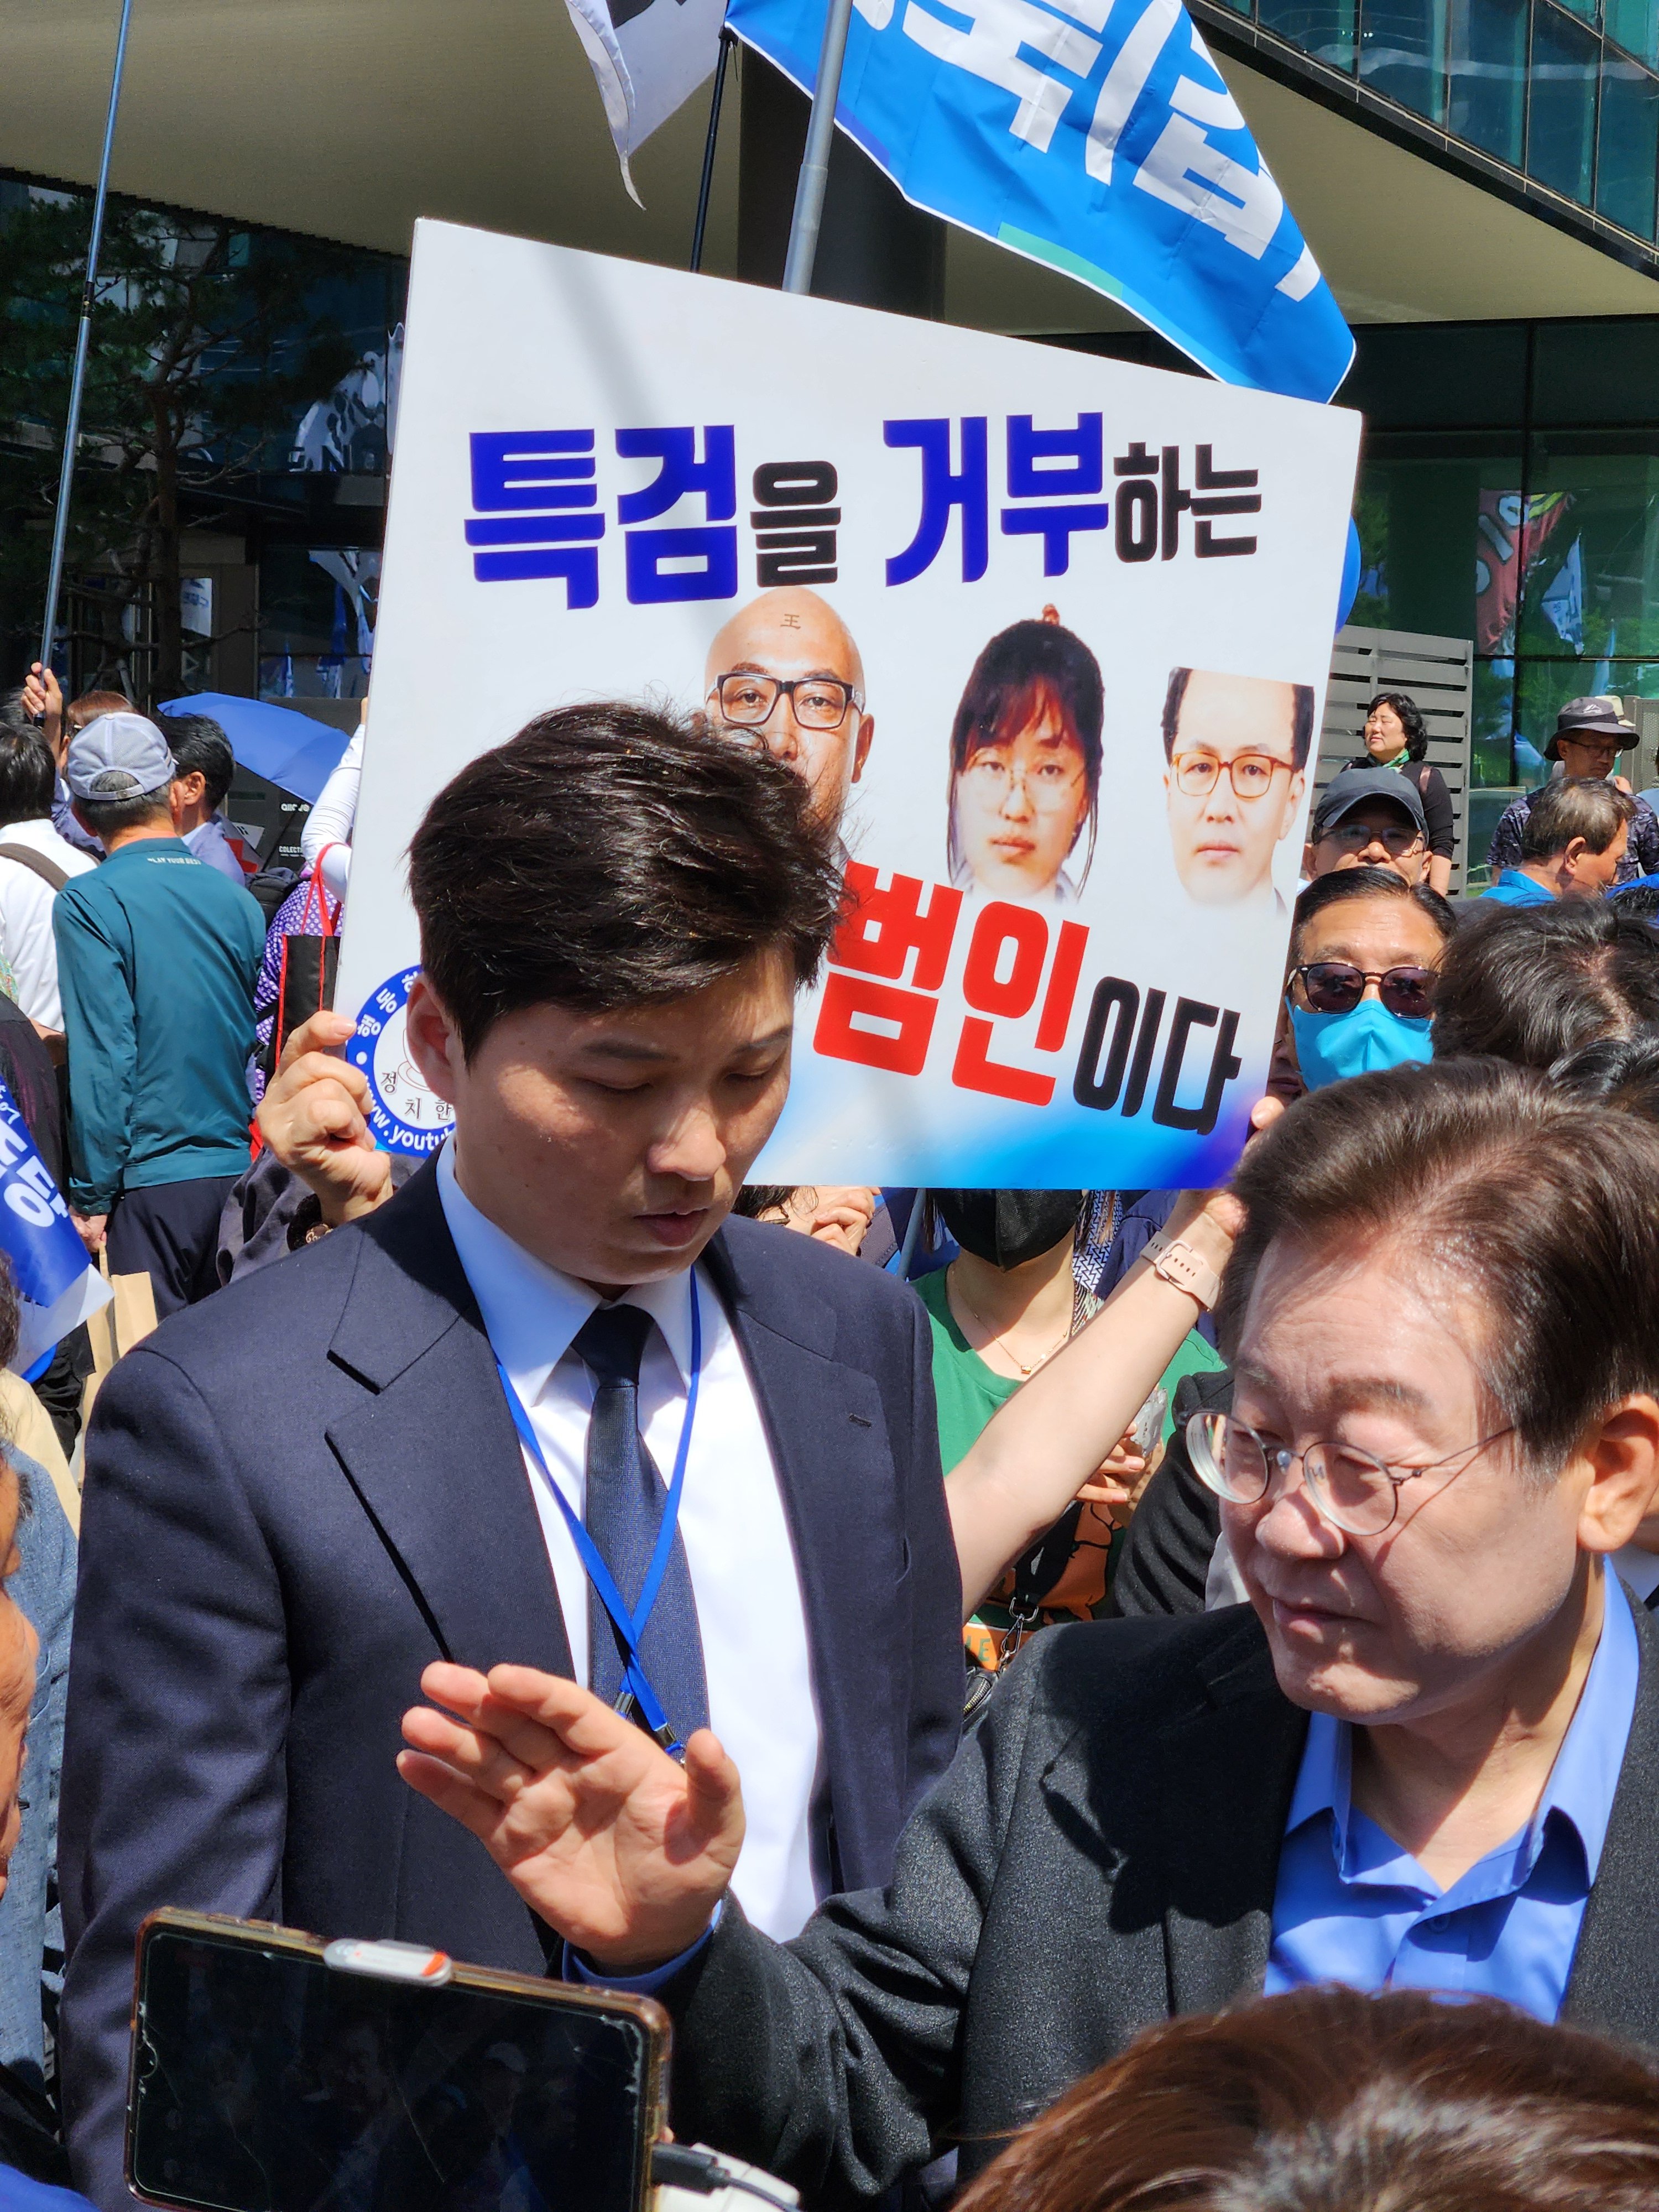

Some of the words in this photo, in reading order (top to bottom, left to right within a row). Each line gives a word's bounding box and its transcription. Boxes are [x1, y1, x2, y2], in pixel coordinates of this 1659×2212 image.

[465, 425, 841, 610] 특검을
[883, 412, 1261, 587] 거부하는
[780, 614, 801, 629] 王
[813, 860, 1241, 1135] 범인이다
